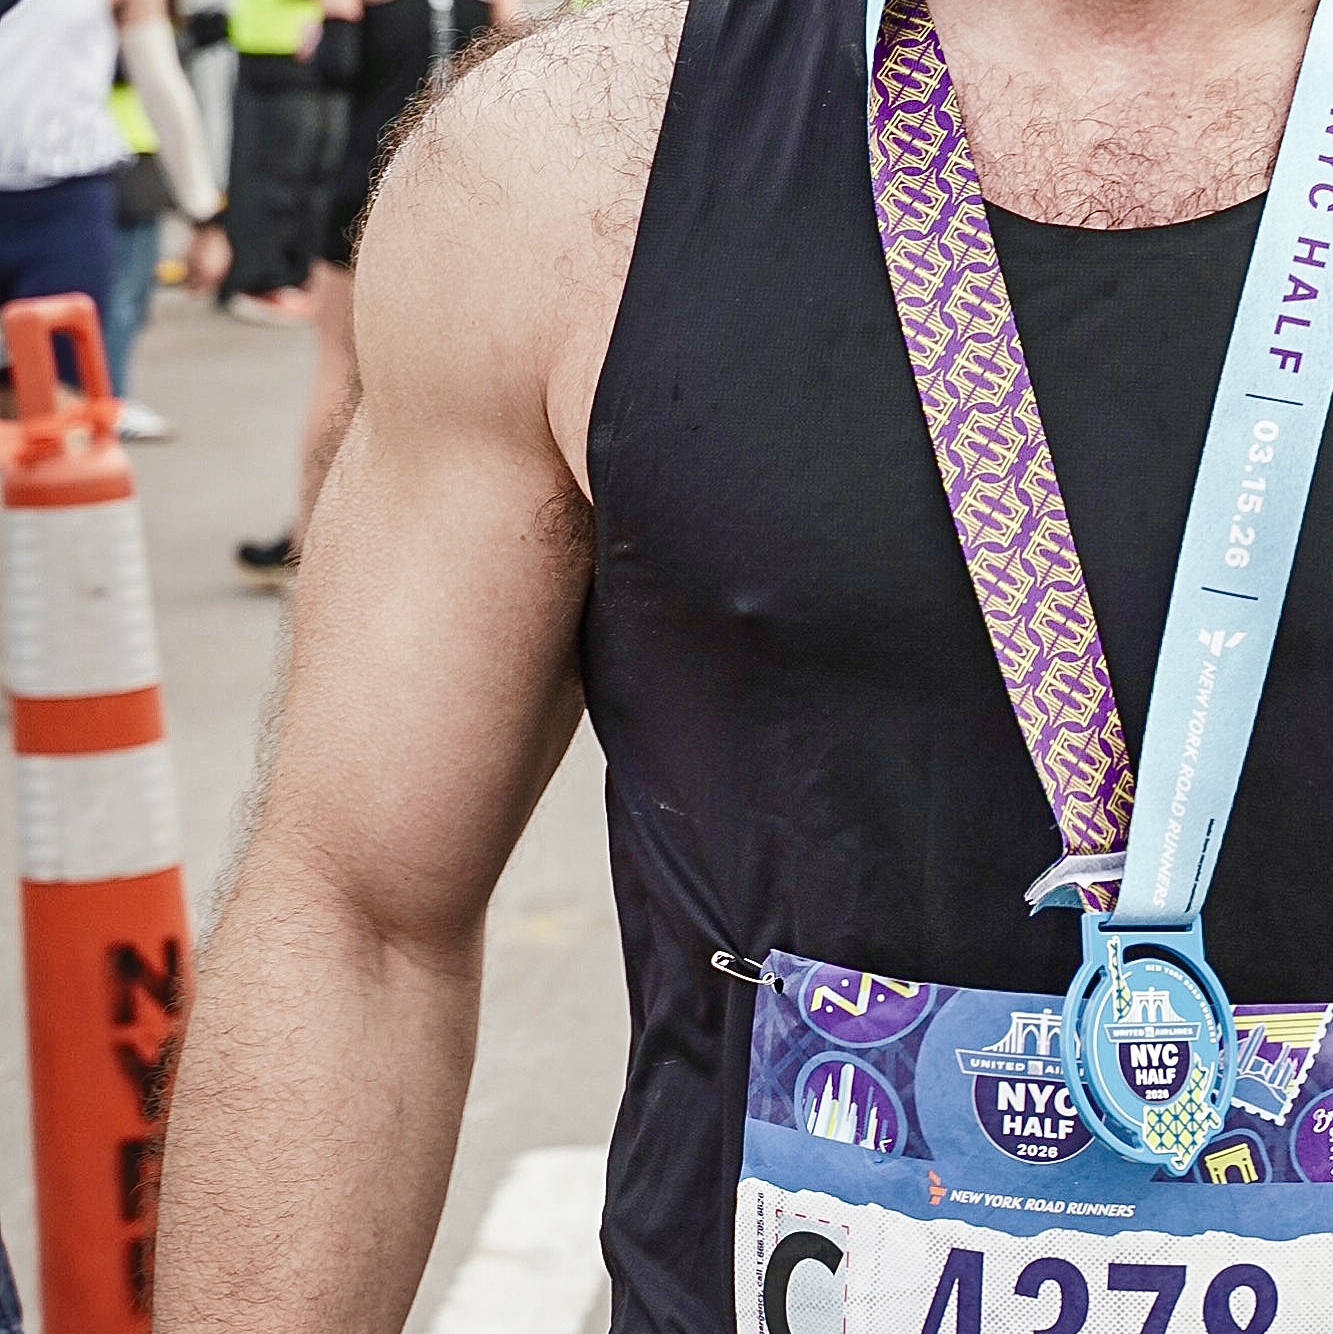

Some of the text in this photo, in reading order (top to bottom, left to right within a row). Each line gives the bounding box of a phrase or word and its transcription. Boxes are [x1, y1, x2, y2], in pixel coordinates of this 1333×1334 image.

[1269, 236, 1331, 375] HALF
[1225, 420, 1280, 568] 03.15.26
[1152, 659, 1218, 909] NEW YORK ROAD RUNNERS
[969, 1057, 1026, 1072] UNITED
[1129, 1043, 1180, 1068] NYC
[1135, 1067, 1177, 1086] HALF
[997, 1080, 1079, 1117] NYC
[1144, 1088, 1170, 1100] 2026
[1002, 1114, 1075, 1141] HALF
[1016, 1143, 1059, 1159] 2026
[950, 1189, 1136, 1218] NEW YORK ROAD RUNNERS
